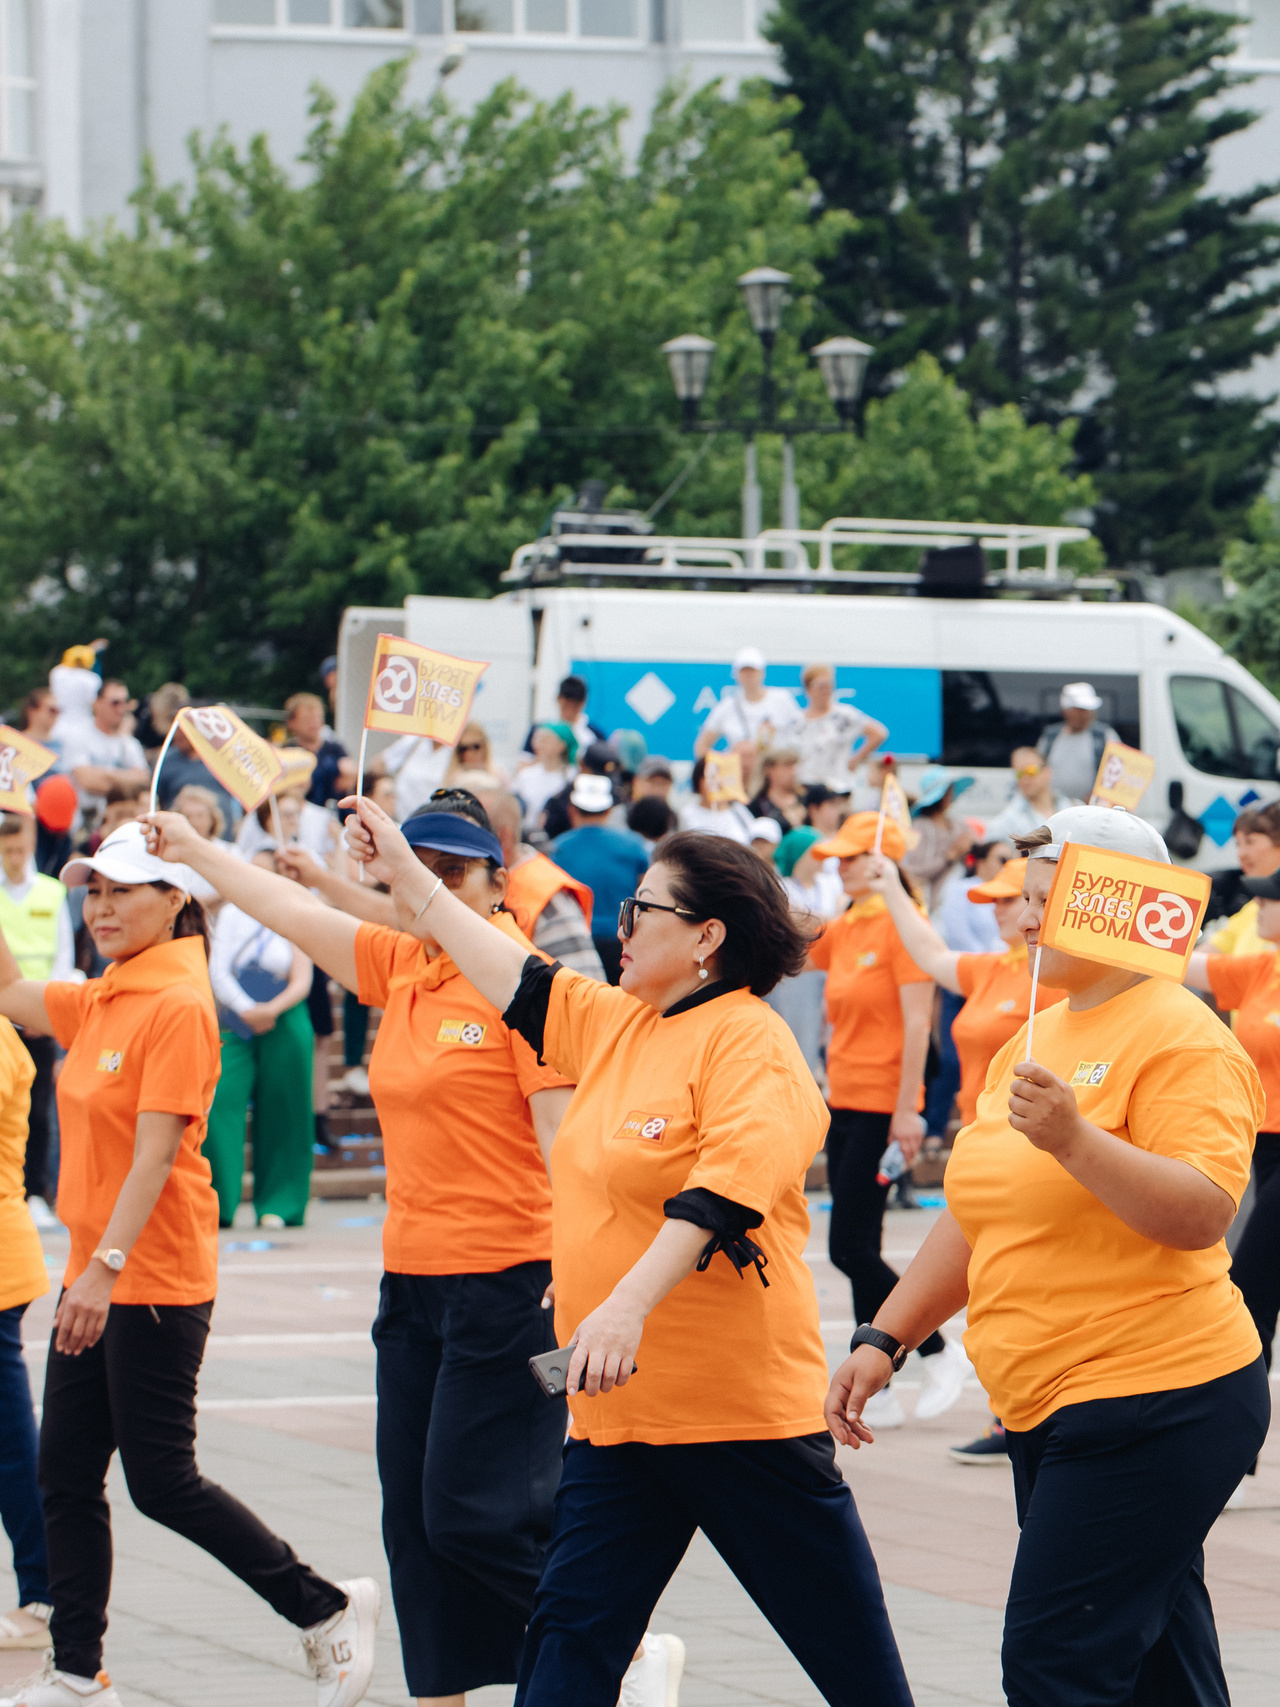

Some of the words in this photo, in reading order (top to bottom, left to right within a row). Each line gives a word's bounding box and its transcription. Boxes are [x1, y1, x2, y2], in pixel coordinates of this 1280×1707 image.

[420, 659, 475, 688] БУРЯТ
[420, 679, 464, 708] ХЛЕБ
[416, 699, 459, 726] ПРОМ
[1072, 871, 1142, 901] БУРЯТ
[1067, 890, 1134, 920] ХЛЕБ
[1062, 909, 1130, 940] ПРОМ
